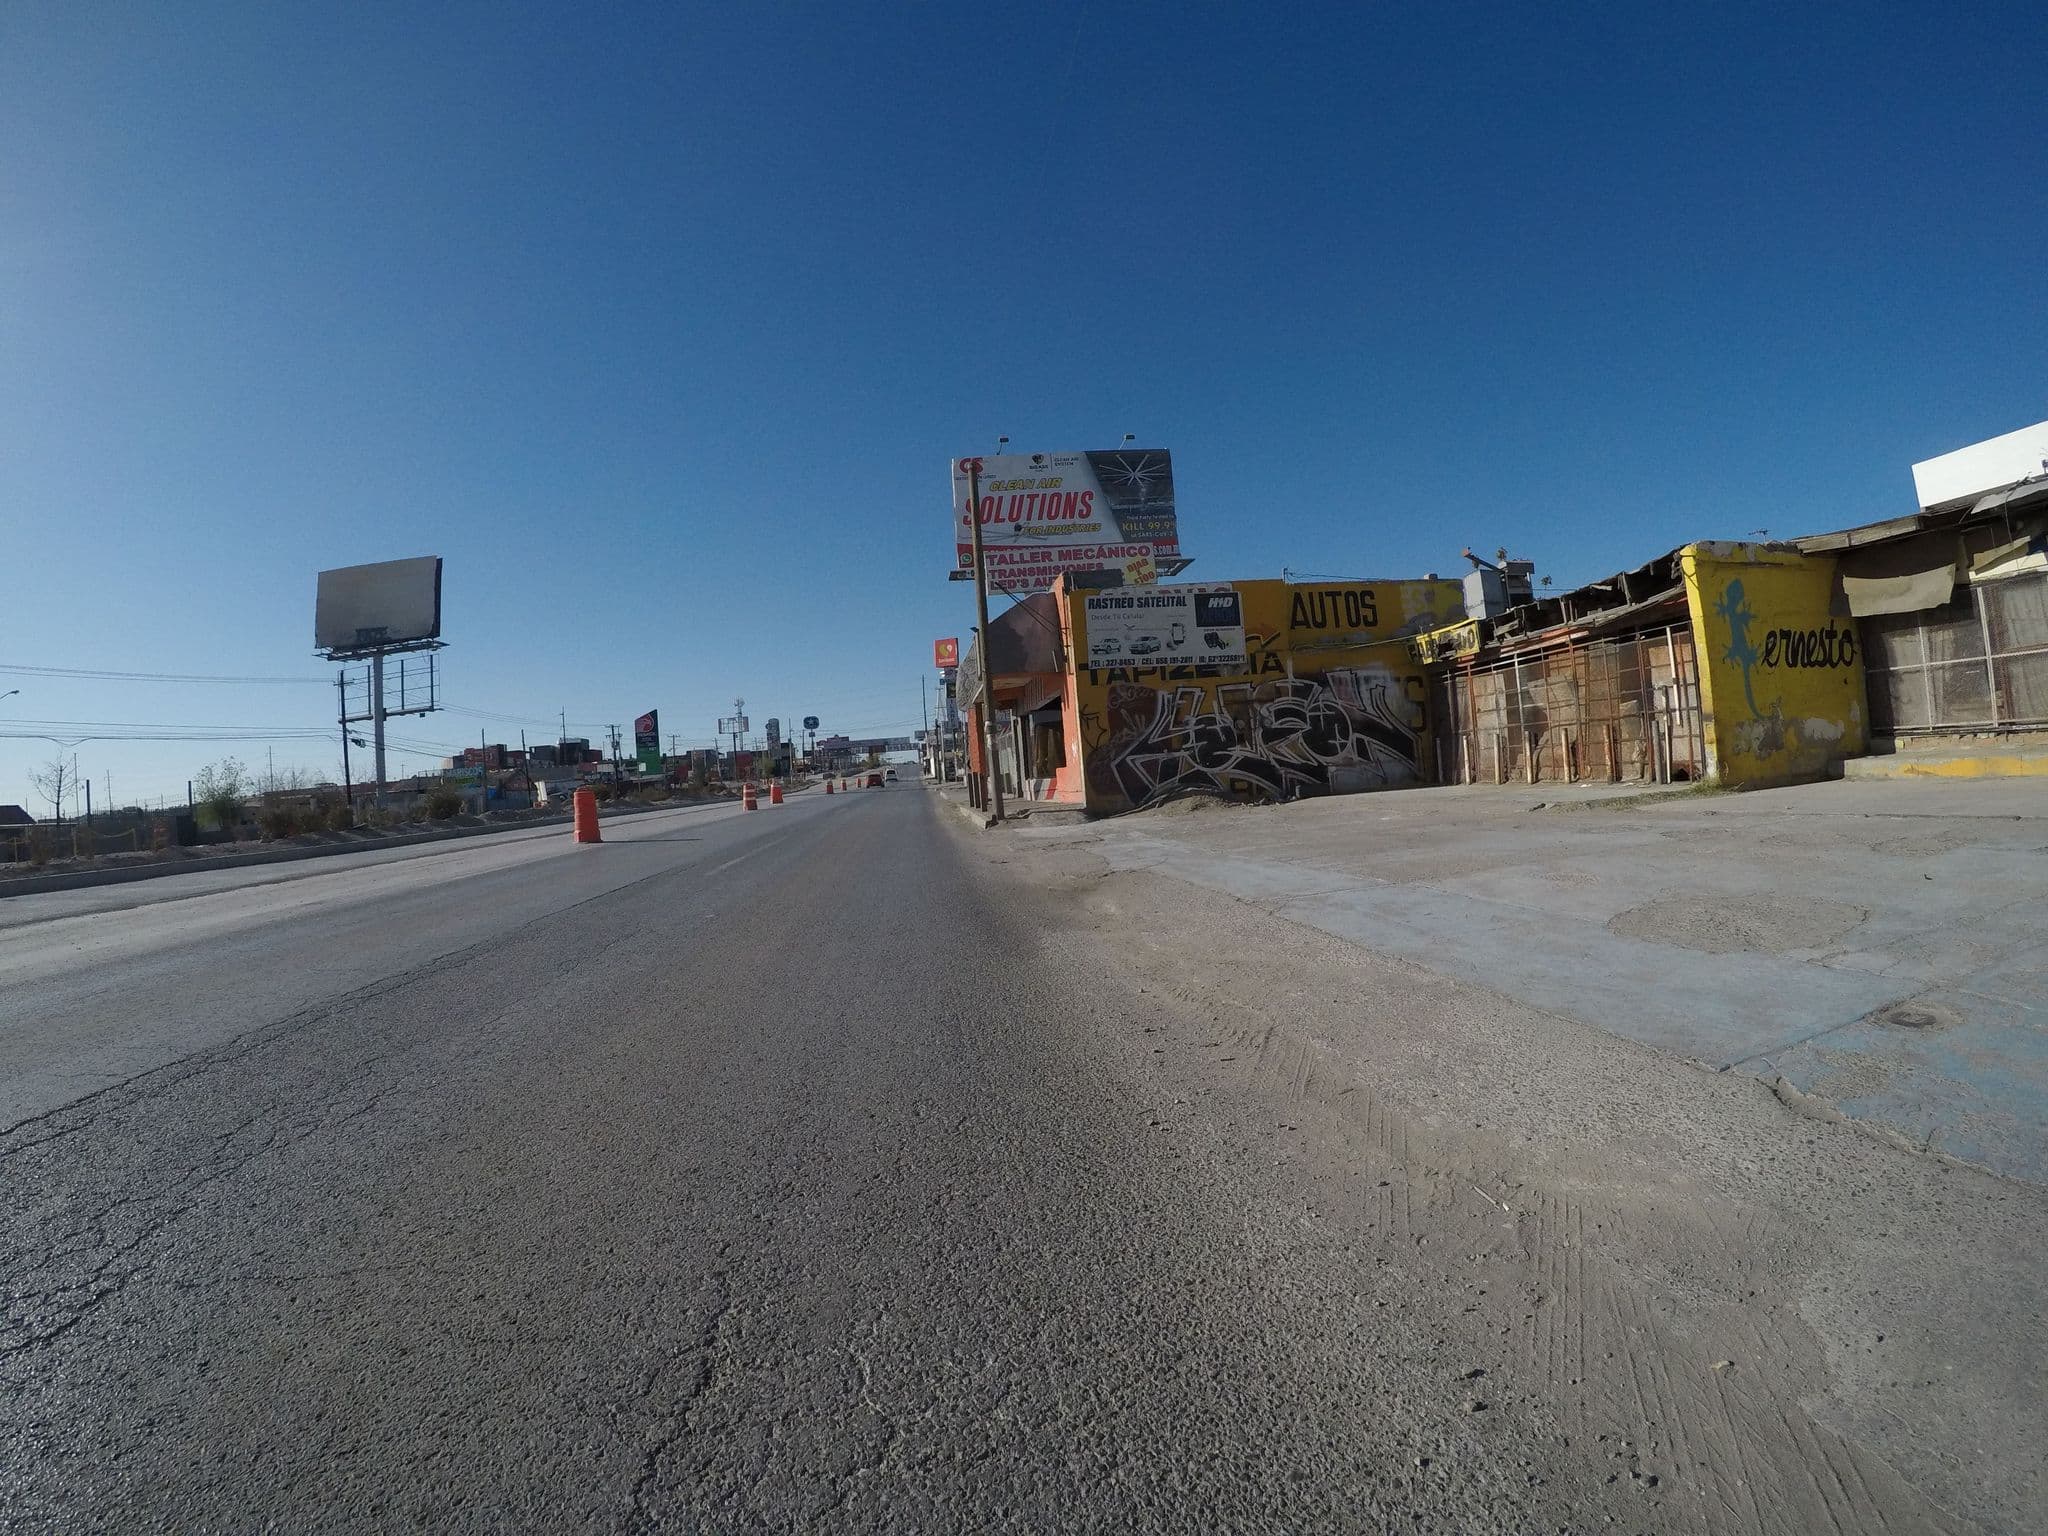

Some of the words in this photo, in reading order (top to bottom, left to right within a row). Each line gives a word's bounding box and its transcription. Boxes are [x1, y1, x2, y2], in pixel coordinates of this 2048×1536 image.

[989, 479, 1034, 492] CLEAN
[1037, 477, 1063, 490] AIR
[962, 491, 1094, 526] SOLUTIONS
[1022, 526, 1043, 537] FOR
[1043, 522, 1102, 535] INDUSTRIES
[1122, 522, 1145, 532] KILL
[986, 550, 1053, 566] TALLER
[1057, 545, 1151, 562] MECÁNICO
[1126, 558, 1149, 573] DIAG
[990, 577, 1030, 591] LED'S
[1088, 596, 1134, 610] RASTREO
[1136, 595, 1188, 609] SATELITAL
[1290, 589, 1379, 630] AUTOS
[1761, 618, 1858, 669] ernesto
[1079, 651, 1285, 686] TAPIZEIA
